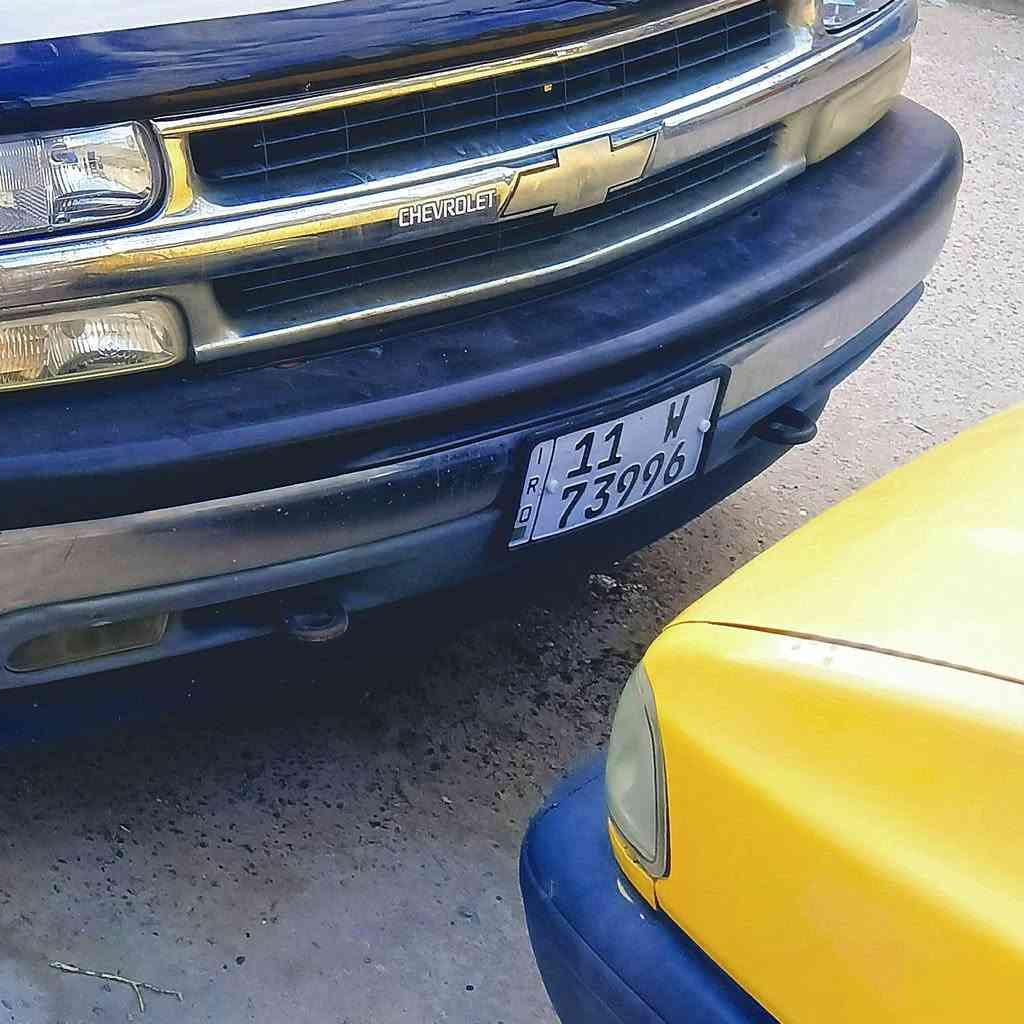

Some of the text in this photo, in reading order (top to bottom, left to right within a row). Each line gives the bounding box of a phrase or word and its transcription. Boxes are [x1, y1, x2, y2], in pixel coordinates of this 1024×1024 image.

[398, 189, 496, 227] CHEVROLET
[567, 422, 625, 479] 11
[558, 440, 686, 529] 73996
